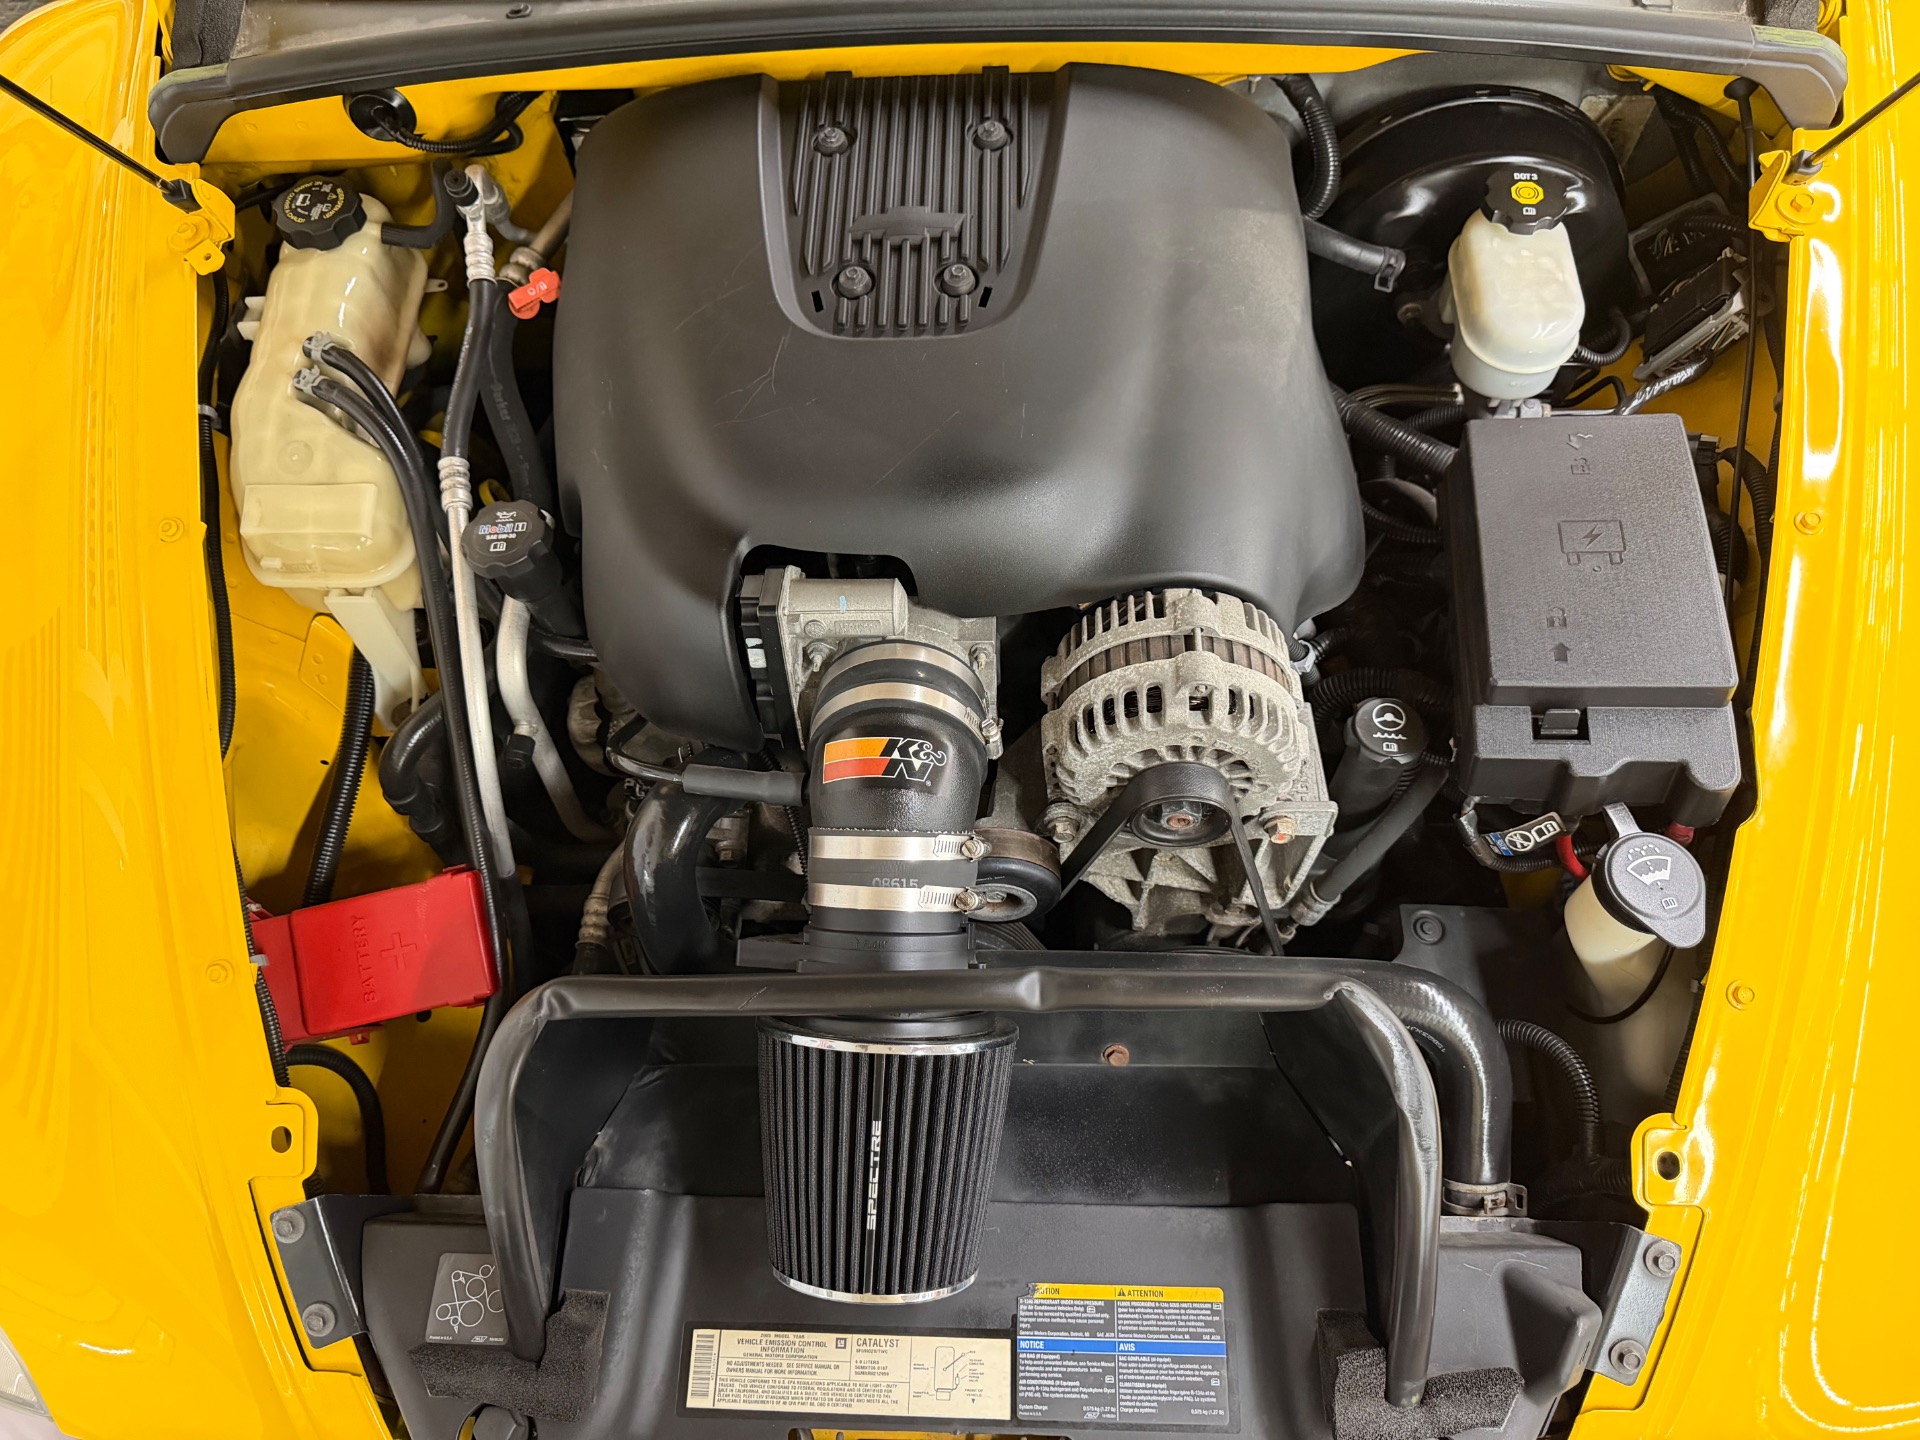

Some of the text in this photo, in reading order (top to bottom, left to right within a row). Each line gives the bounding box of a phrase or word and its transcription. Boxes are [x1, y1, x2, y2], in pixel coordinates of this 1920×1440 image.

[1513, 172, 1531, 180] DOT
[478, 522, 514, 534] Mobil
[879, 738, 947, 783] K&N
[350, 914, 378, 1004] BATTERY
[866, 1120, 882, 1230] SPECTRE
[857, 1338, 900, 1348] CATALYST
[1020, 1341, 1044, 1349] NOTICE
[1119, 1343, 1135, 1351] AVIS
